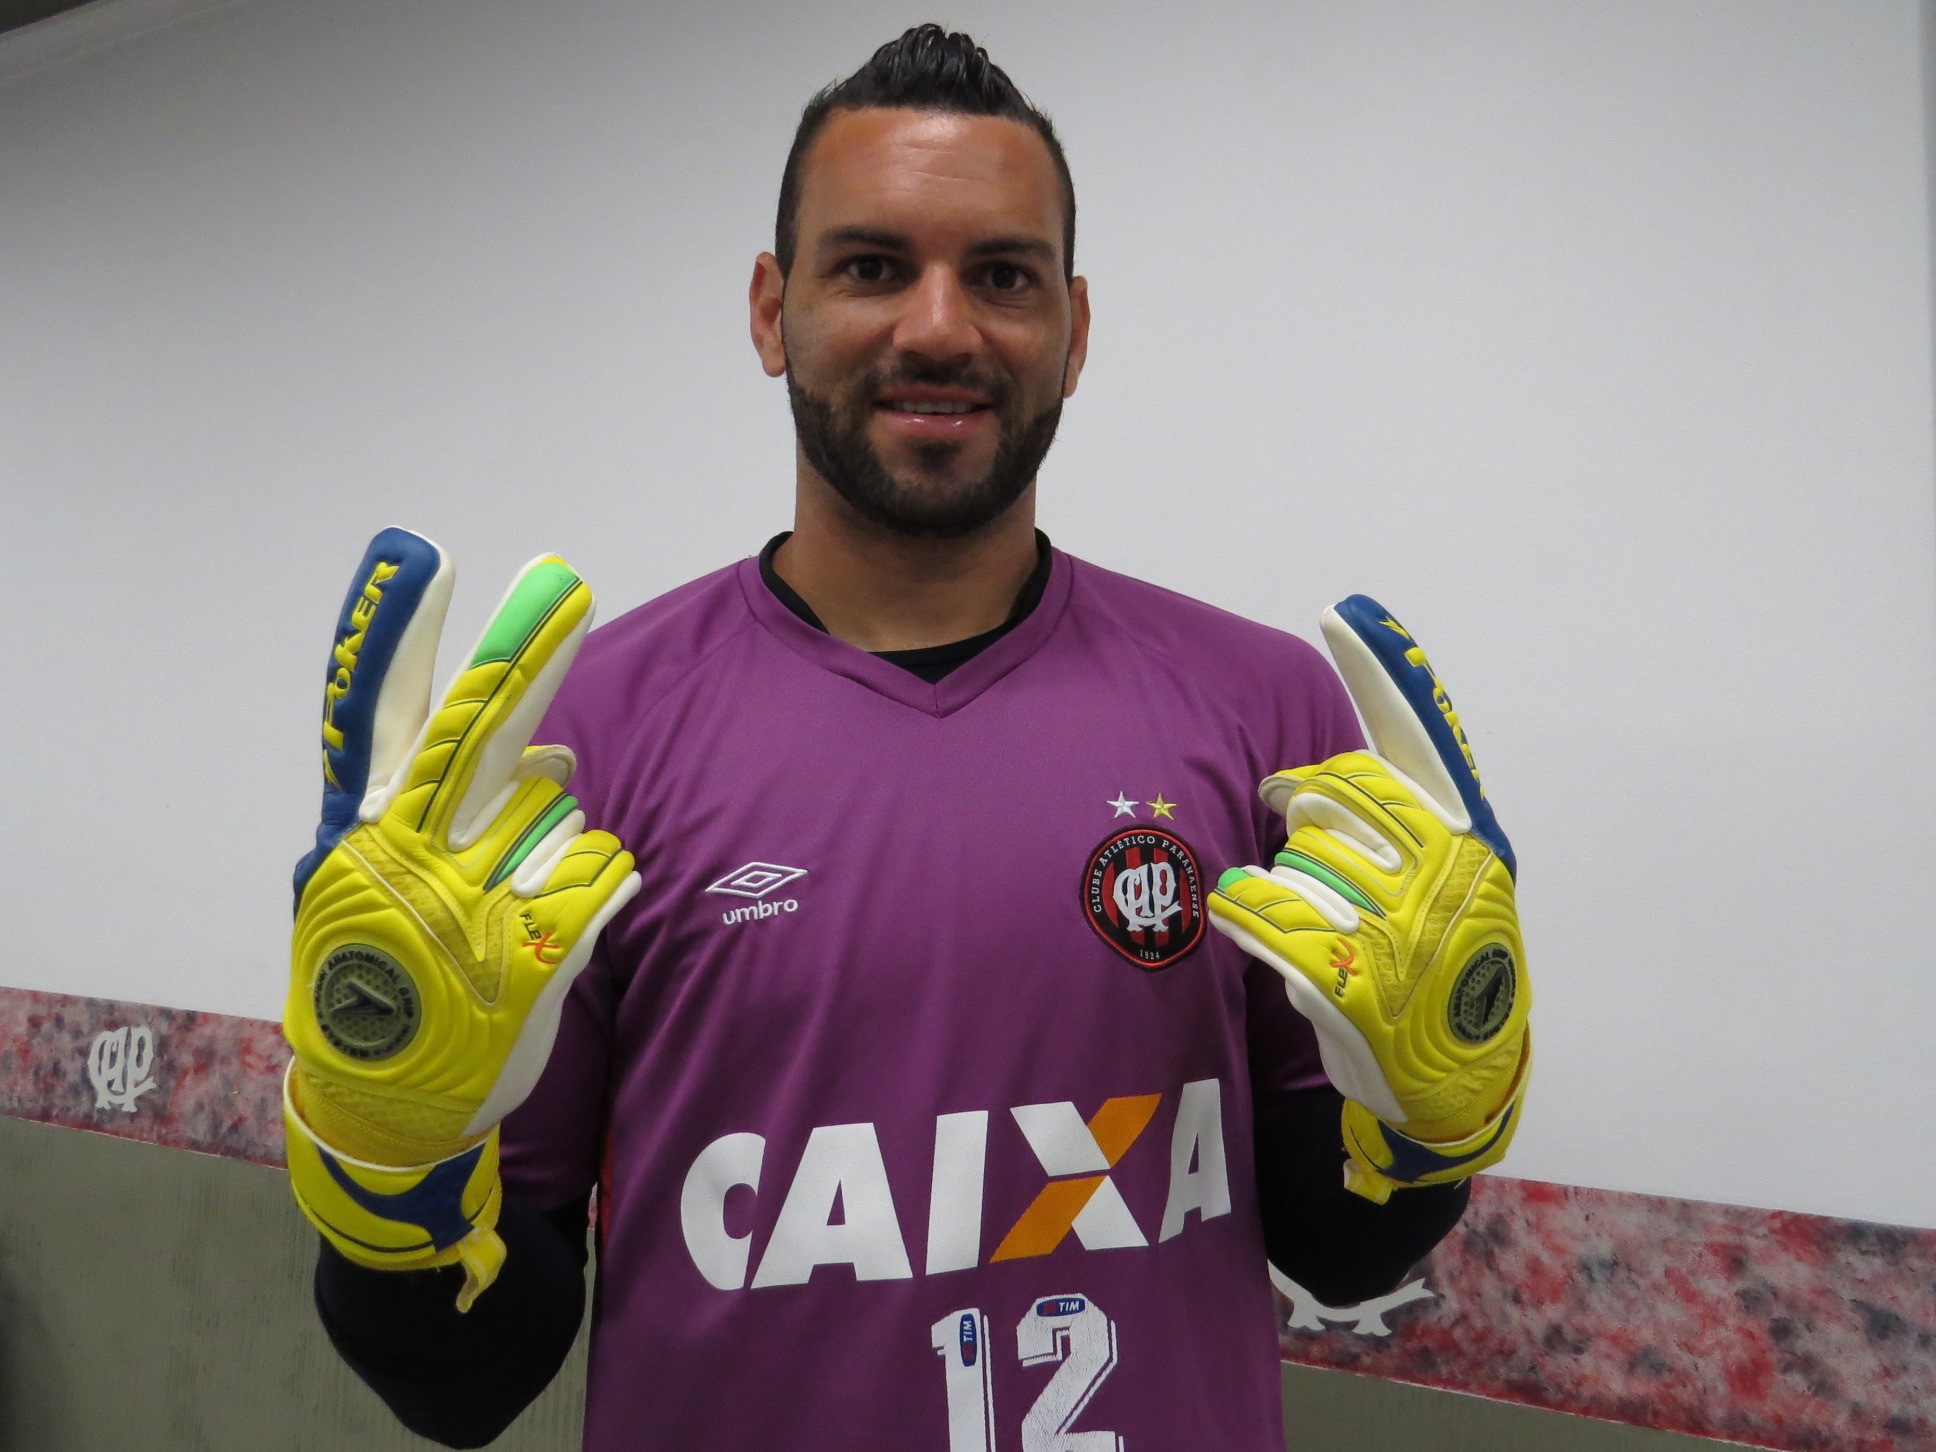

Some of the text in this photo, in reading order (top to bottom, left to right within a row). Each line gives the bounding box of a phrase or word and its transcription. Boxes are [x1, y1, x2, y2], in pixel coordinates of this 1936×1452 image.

[1091, 869, 1102, 912] CLUBE
[1161, 839, 1199, 918] PARANAENSE
[722, 899, 799, 925] umbro
[1139, 950, 1160, 960] 1924
[680, 1078, 1232, 1291] CAIXA
[1059, 1301, 1080, 1313] TIM
[963, 1320, 973, 1342] TIM
[931, 1292, 1125, 1452] 12
